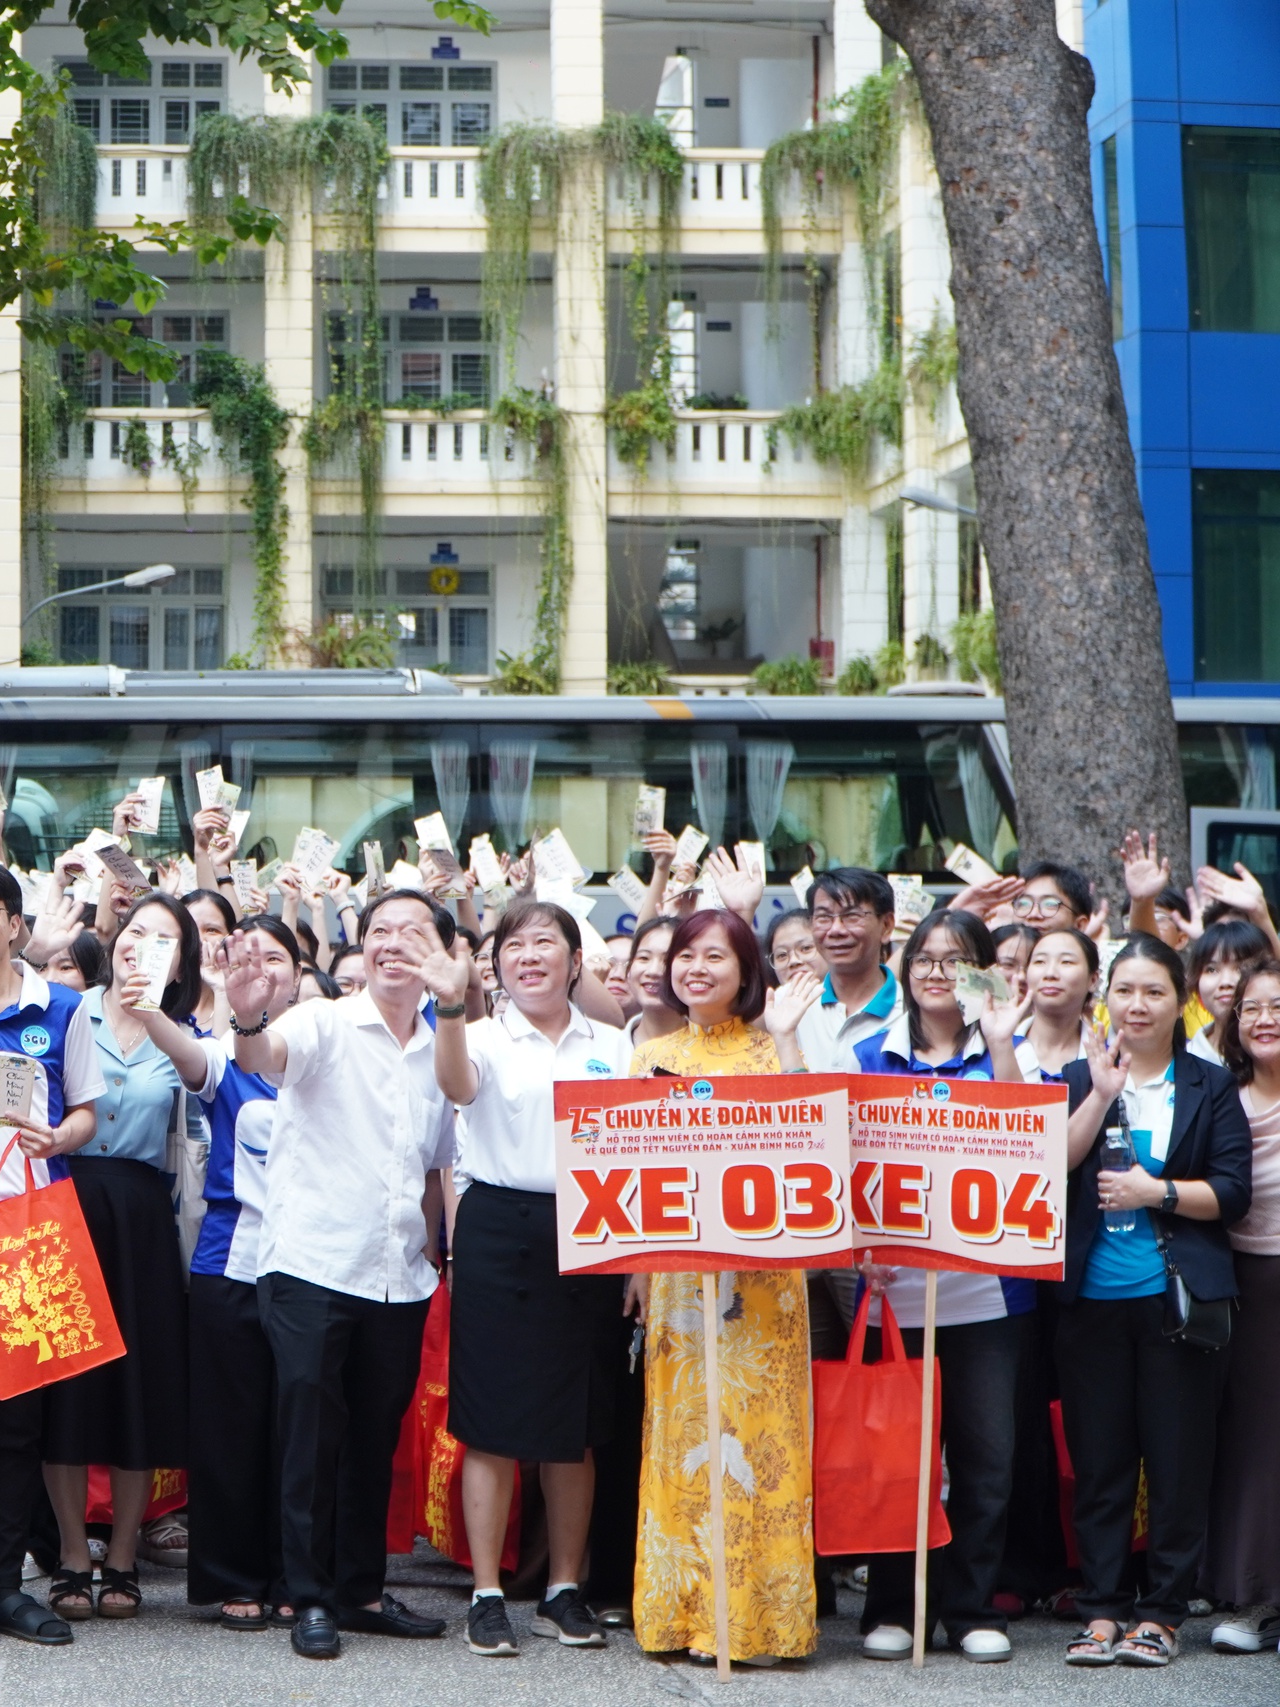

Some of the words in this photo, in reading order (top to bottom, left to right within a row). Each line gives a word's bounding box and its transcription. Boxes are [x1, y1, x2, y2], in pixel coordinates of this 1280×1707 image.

[24, 1034, 48, 1046] SGU
[604, 1099, 681, 1129] CHUYẾN
[687, 1107, 712, 1127] XE
[717, 1100, 772, 1126] ĐOÀN
[777, 1099, 823, 1124] VIÊN
[858, 1095, 922, 1126] CHUYẾN
[927, 1108, 948, 1128] XE
[952, 1105, 1000, 1131] ĐOÀN
[1004, 1108, 1045, 1134] VIÊN
[668, 1132, 689, 1141] VIÊN
[692, 1131, 703, 1141] CÓ
[706, 1131, 732, 1140] HOÀN
[763, 1130, 782, 1139] KHÓ
[889, 1131, 906, 1139] SINH
[909, 1130, 927, 1140] VIÊN
[599, 1145, 617, 1154] QUÊ
[662, 1142, 700, 1152] NGUYÊN
[730, 1141, 756, 1150] XUÂN
[568, 1166, 695, 1241] XE
[720, 1162, 840, 1236] 03
[949, 1167, 1058, 1246] 04
